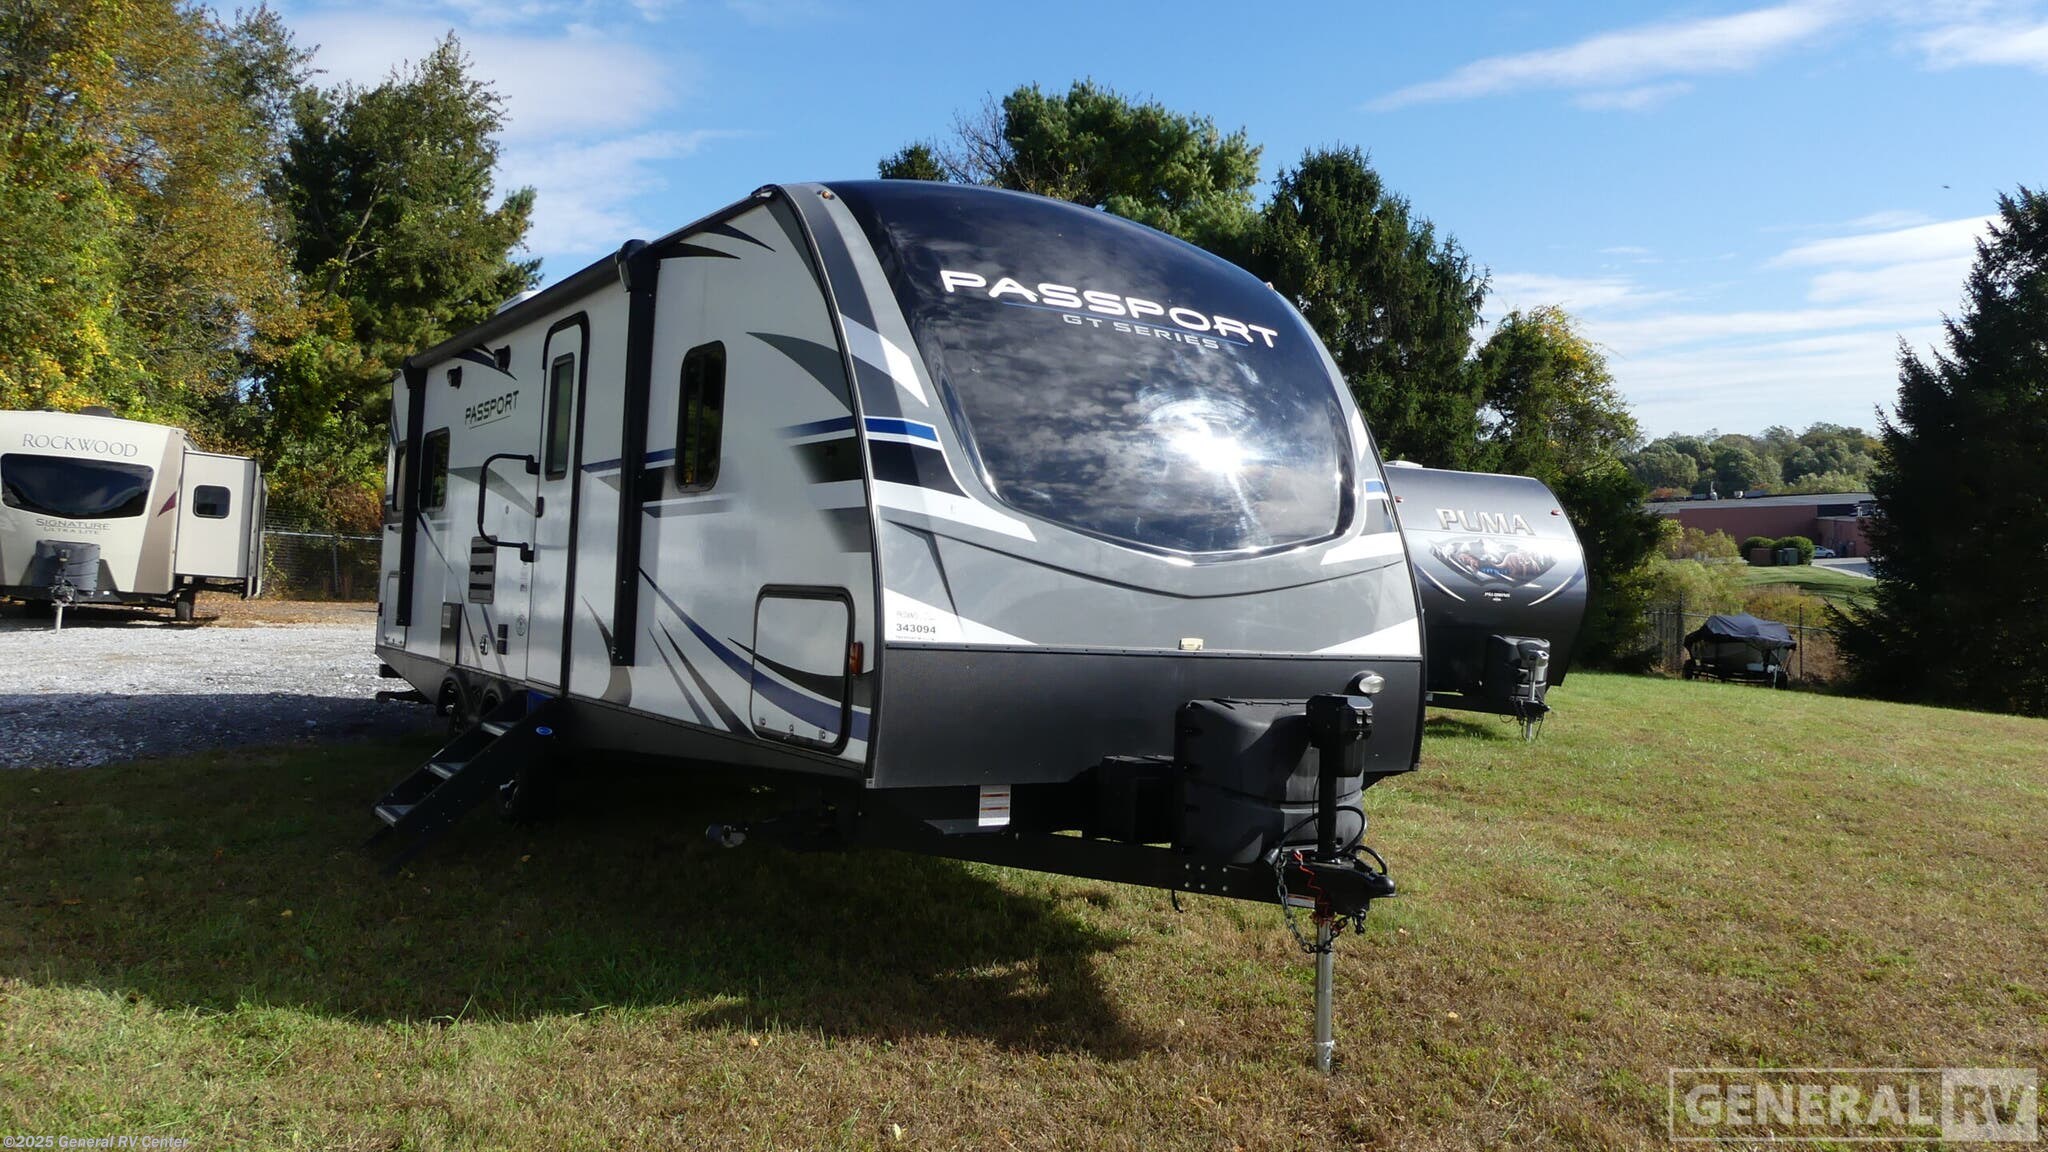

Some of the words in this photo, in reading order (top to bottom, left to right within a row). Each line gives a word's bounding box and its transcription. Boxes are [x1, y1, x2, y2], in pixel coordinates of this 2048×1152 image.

[940, 269, 1279, 348] PASSPORT
[1063, 313, 1103, 328] GT
[1112, 321, 1221, 350] SERIES
[464, 390, 520, 425] PASSPORT
[22, 433, 138, 457] ROCKWOOD
[35, 518, 112, 531] SIGNATURE
[1436, 508, 1536, 536] PUMA
[897, 623, 936, 634] 343094
